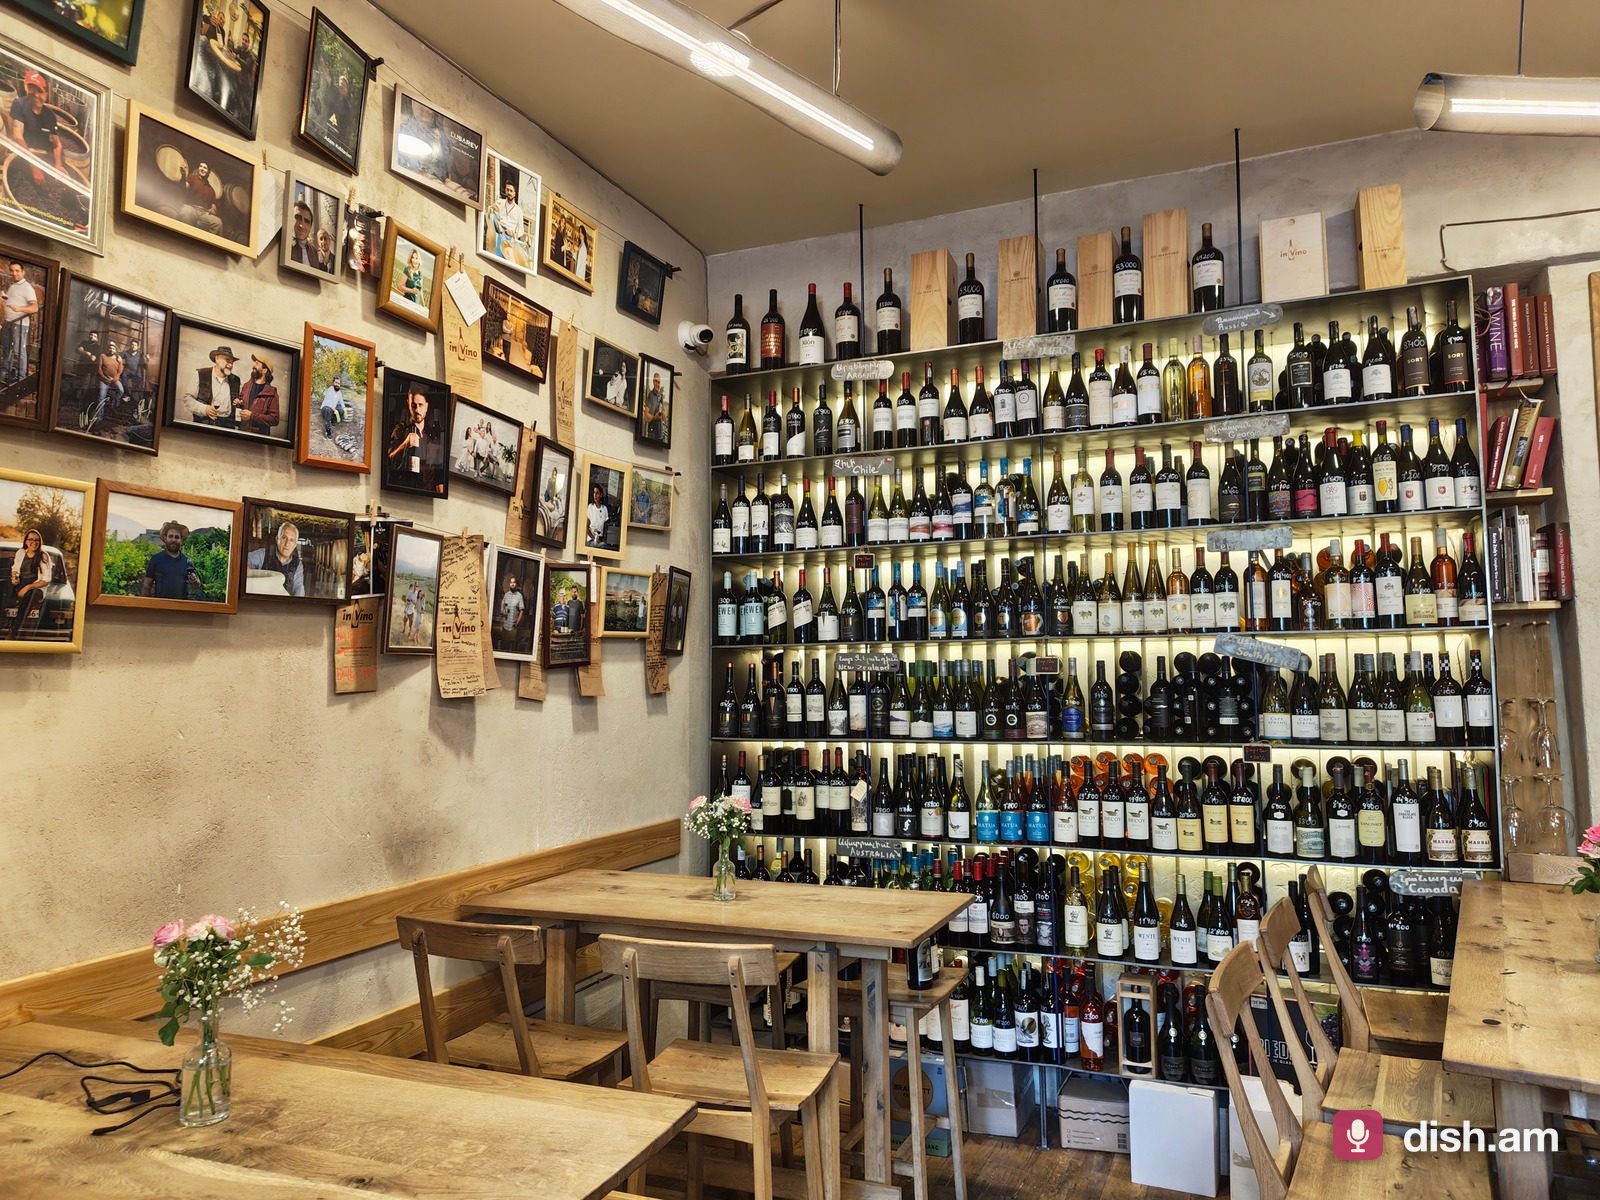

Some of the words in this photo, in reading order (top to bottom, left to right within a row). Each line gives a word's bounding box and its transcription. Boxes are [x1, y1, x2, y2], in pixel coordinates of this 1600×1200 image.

[1290, 248, 1307, 256] Vino
[1488, 312, 1502, 352] WINE
[448, 341, 457, 352] in
[460, 344, 478, 357] Vino
[852, 464, 879, 474] Chile
[342, 609, 352, 621] in
[355, 608, 374, 621] Vino
[442, 622, 452, 633] in
[455, 621, 476, 633] Vino
[856, 663, 890, 671] Zealand
[850, 846, 895, 859] AUSTRALIA
[1408, 883, 1459, 894] Canada
